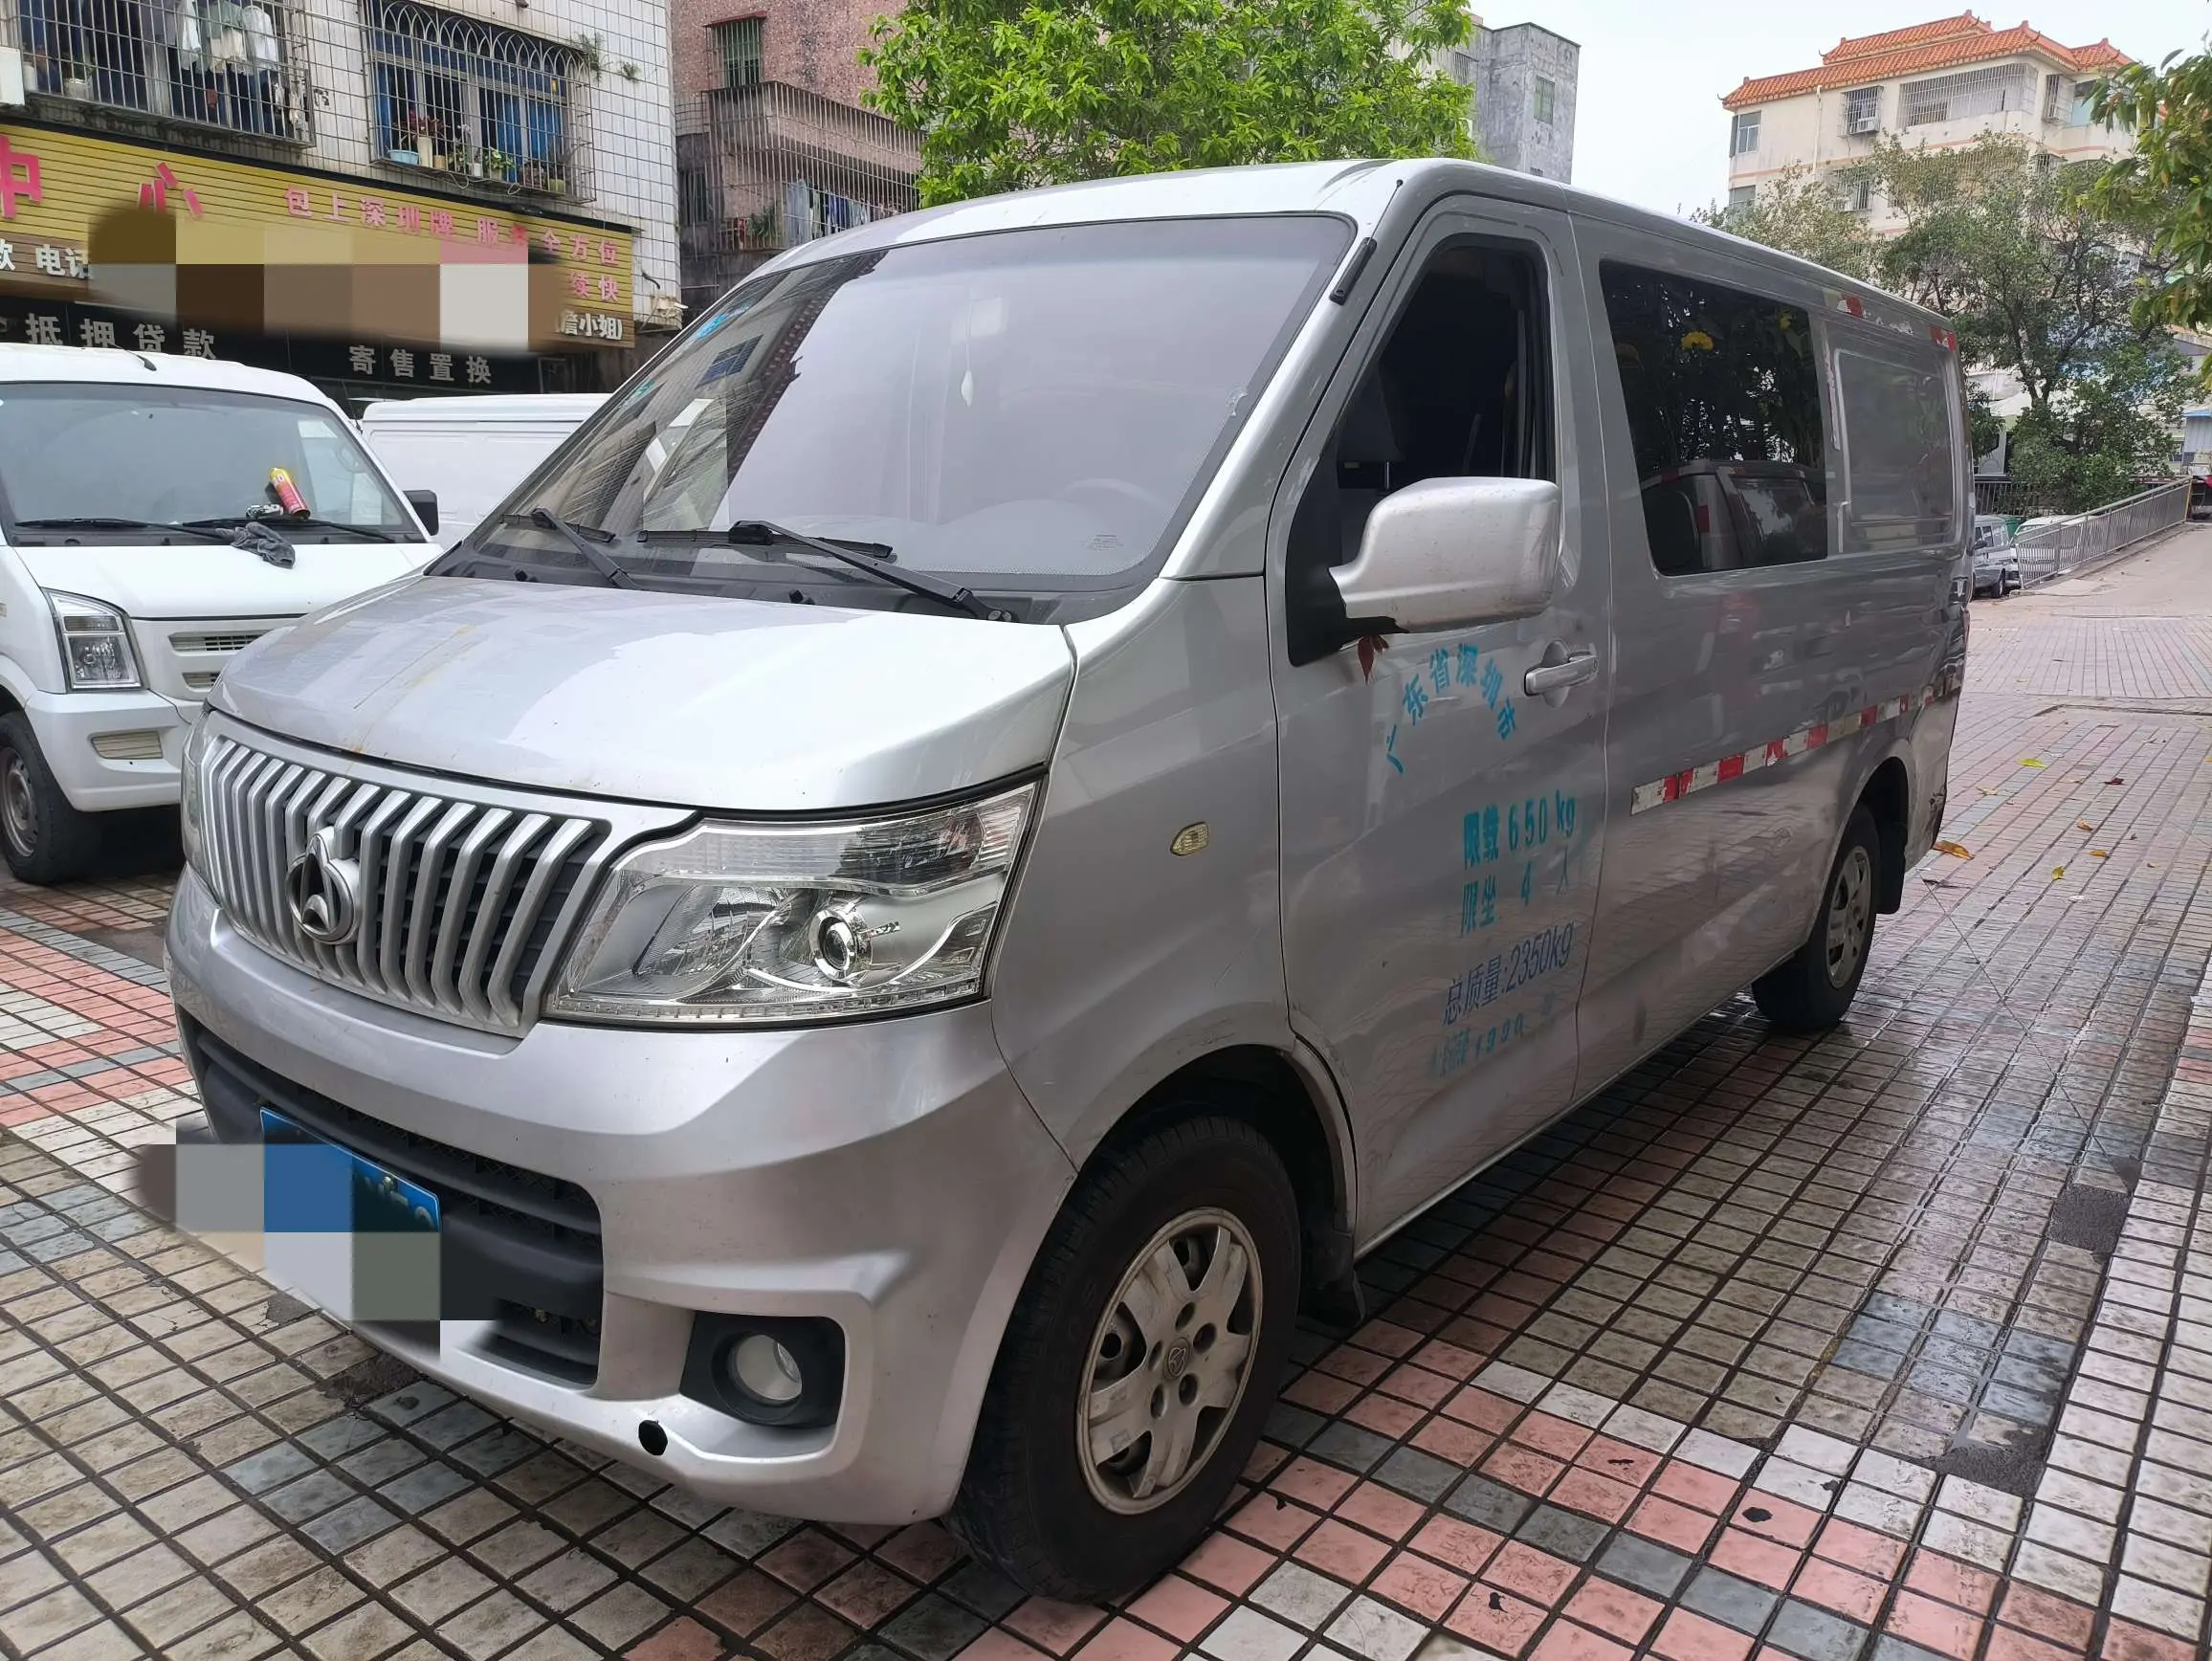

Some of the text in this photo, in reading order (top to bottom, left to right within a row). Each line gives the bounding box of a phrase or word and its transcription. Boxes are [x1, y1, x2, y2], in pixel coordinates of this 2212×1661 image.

[26, 312, 217, 360] 抵押贷款
[348, 344, 492, 384] 寄售置换
